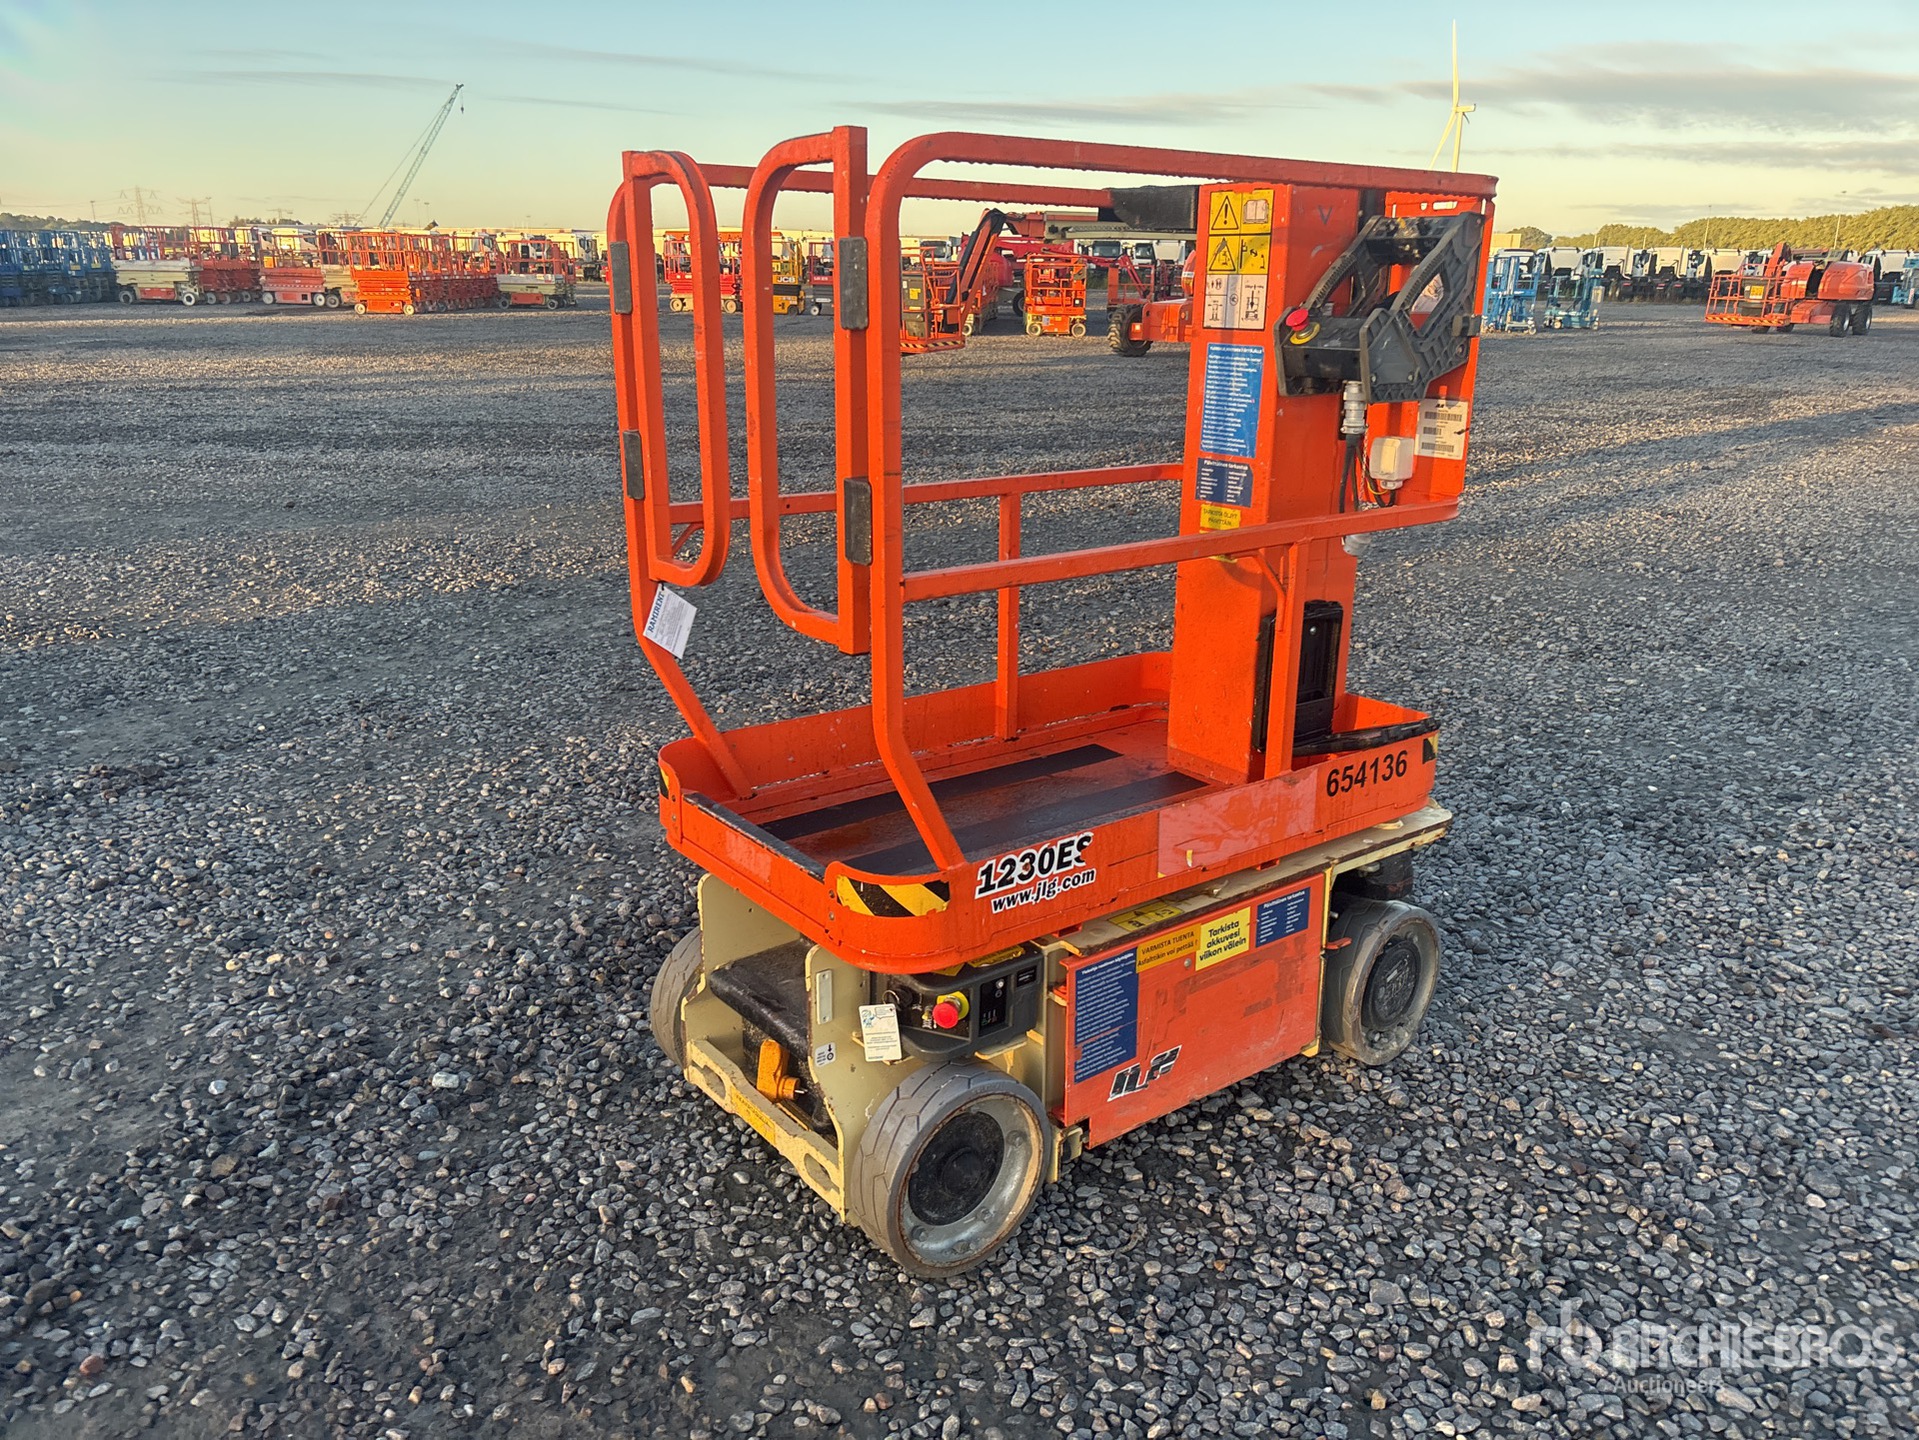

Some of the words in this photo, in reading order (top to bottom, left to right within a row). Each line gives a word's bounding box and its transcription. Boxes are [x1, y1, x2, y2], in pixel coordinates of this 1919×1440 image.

[777, 275, 796, 283] JCB
[647, 591, 665, 633] RAMIRENT
[1326, 750, 1408, 797] 654136
[976, 832, 1093, 898] 1230ES
[992, 869, 1096, 913] www.jlg.com
[1206, 928, 1241, 948] akkuvesi
[1208, 920, 1240, 937] Tarkista
[1141, 940, 1171, 955] VARMISTA
[1172, 931, 1194, 943] TUENTA
[1166, 948, 1176, 956] voi
[1199, 947, 1222, 961] viikon
[1223, 937, 1246, 951] välein
